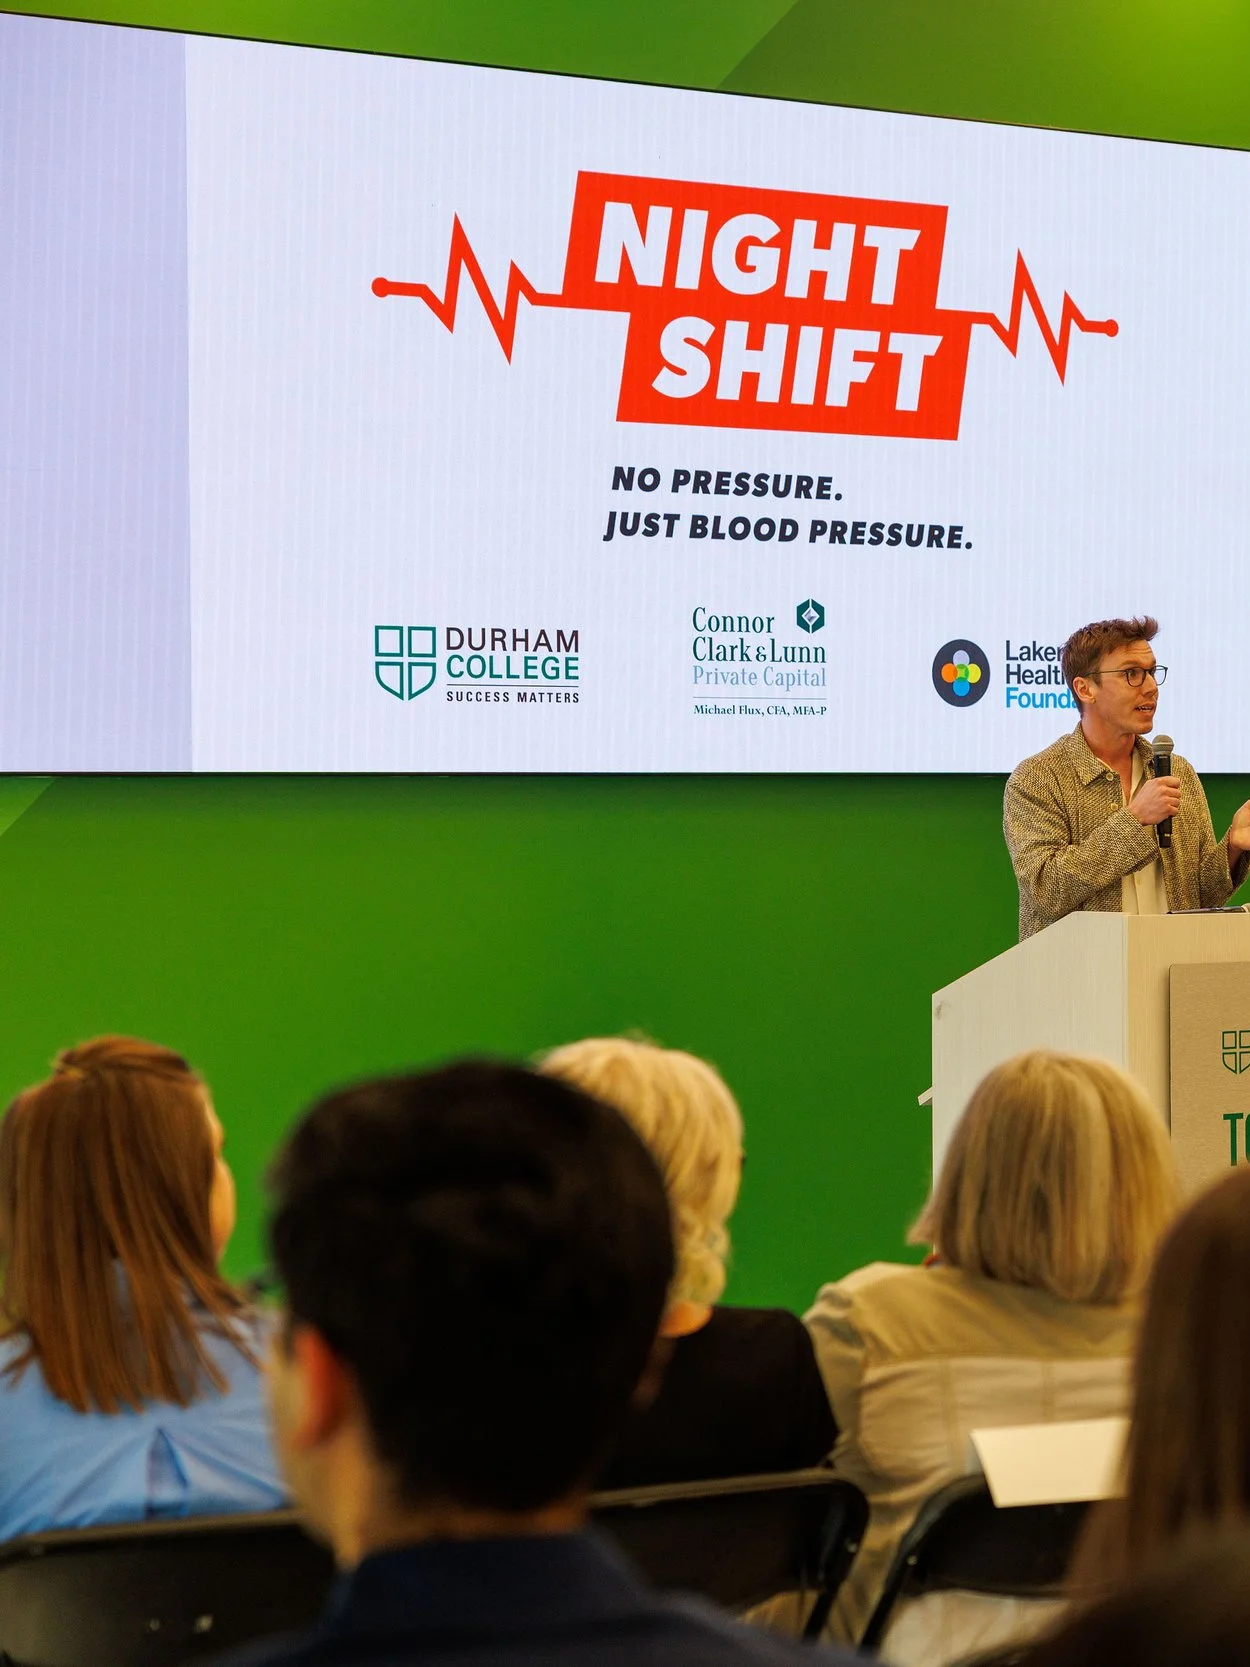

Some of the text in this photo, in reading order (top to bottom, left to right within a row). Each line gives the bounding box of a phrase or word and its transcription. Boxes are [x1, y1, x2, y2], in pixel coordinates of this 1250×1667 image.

[594, 200, 921, 308] NIGHT
[652, 316, 942, 411] SHIFT
[612, 466, 842, 501] NO PRESSURE.
[603, 511, 972, 549] JUST BLOOD PRESSURE.
[693, 607, 774, 633] Connor
[446, 627, 579, 653] DURHAM
[1006, 640, 1062, 661] Laker
[447, 655, 579, 680] COLLEGE
[693, 666, 825, 691] Private Capital
[447, 691, 578, 703] SUCCESS MATTERS
[1006, 687, 1077, 709] Found
[693, 704, 826, 716] Michael Flux, CFA, MFA-P
